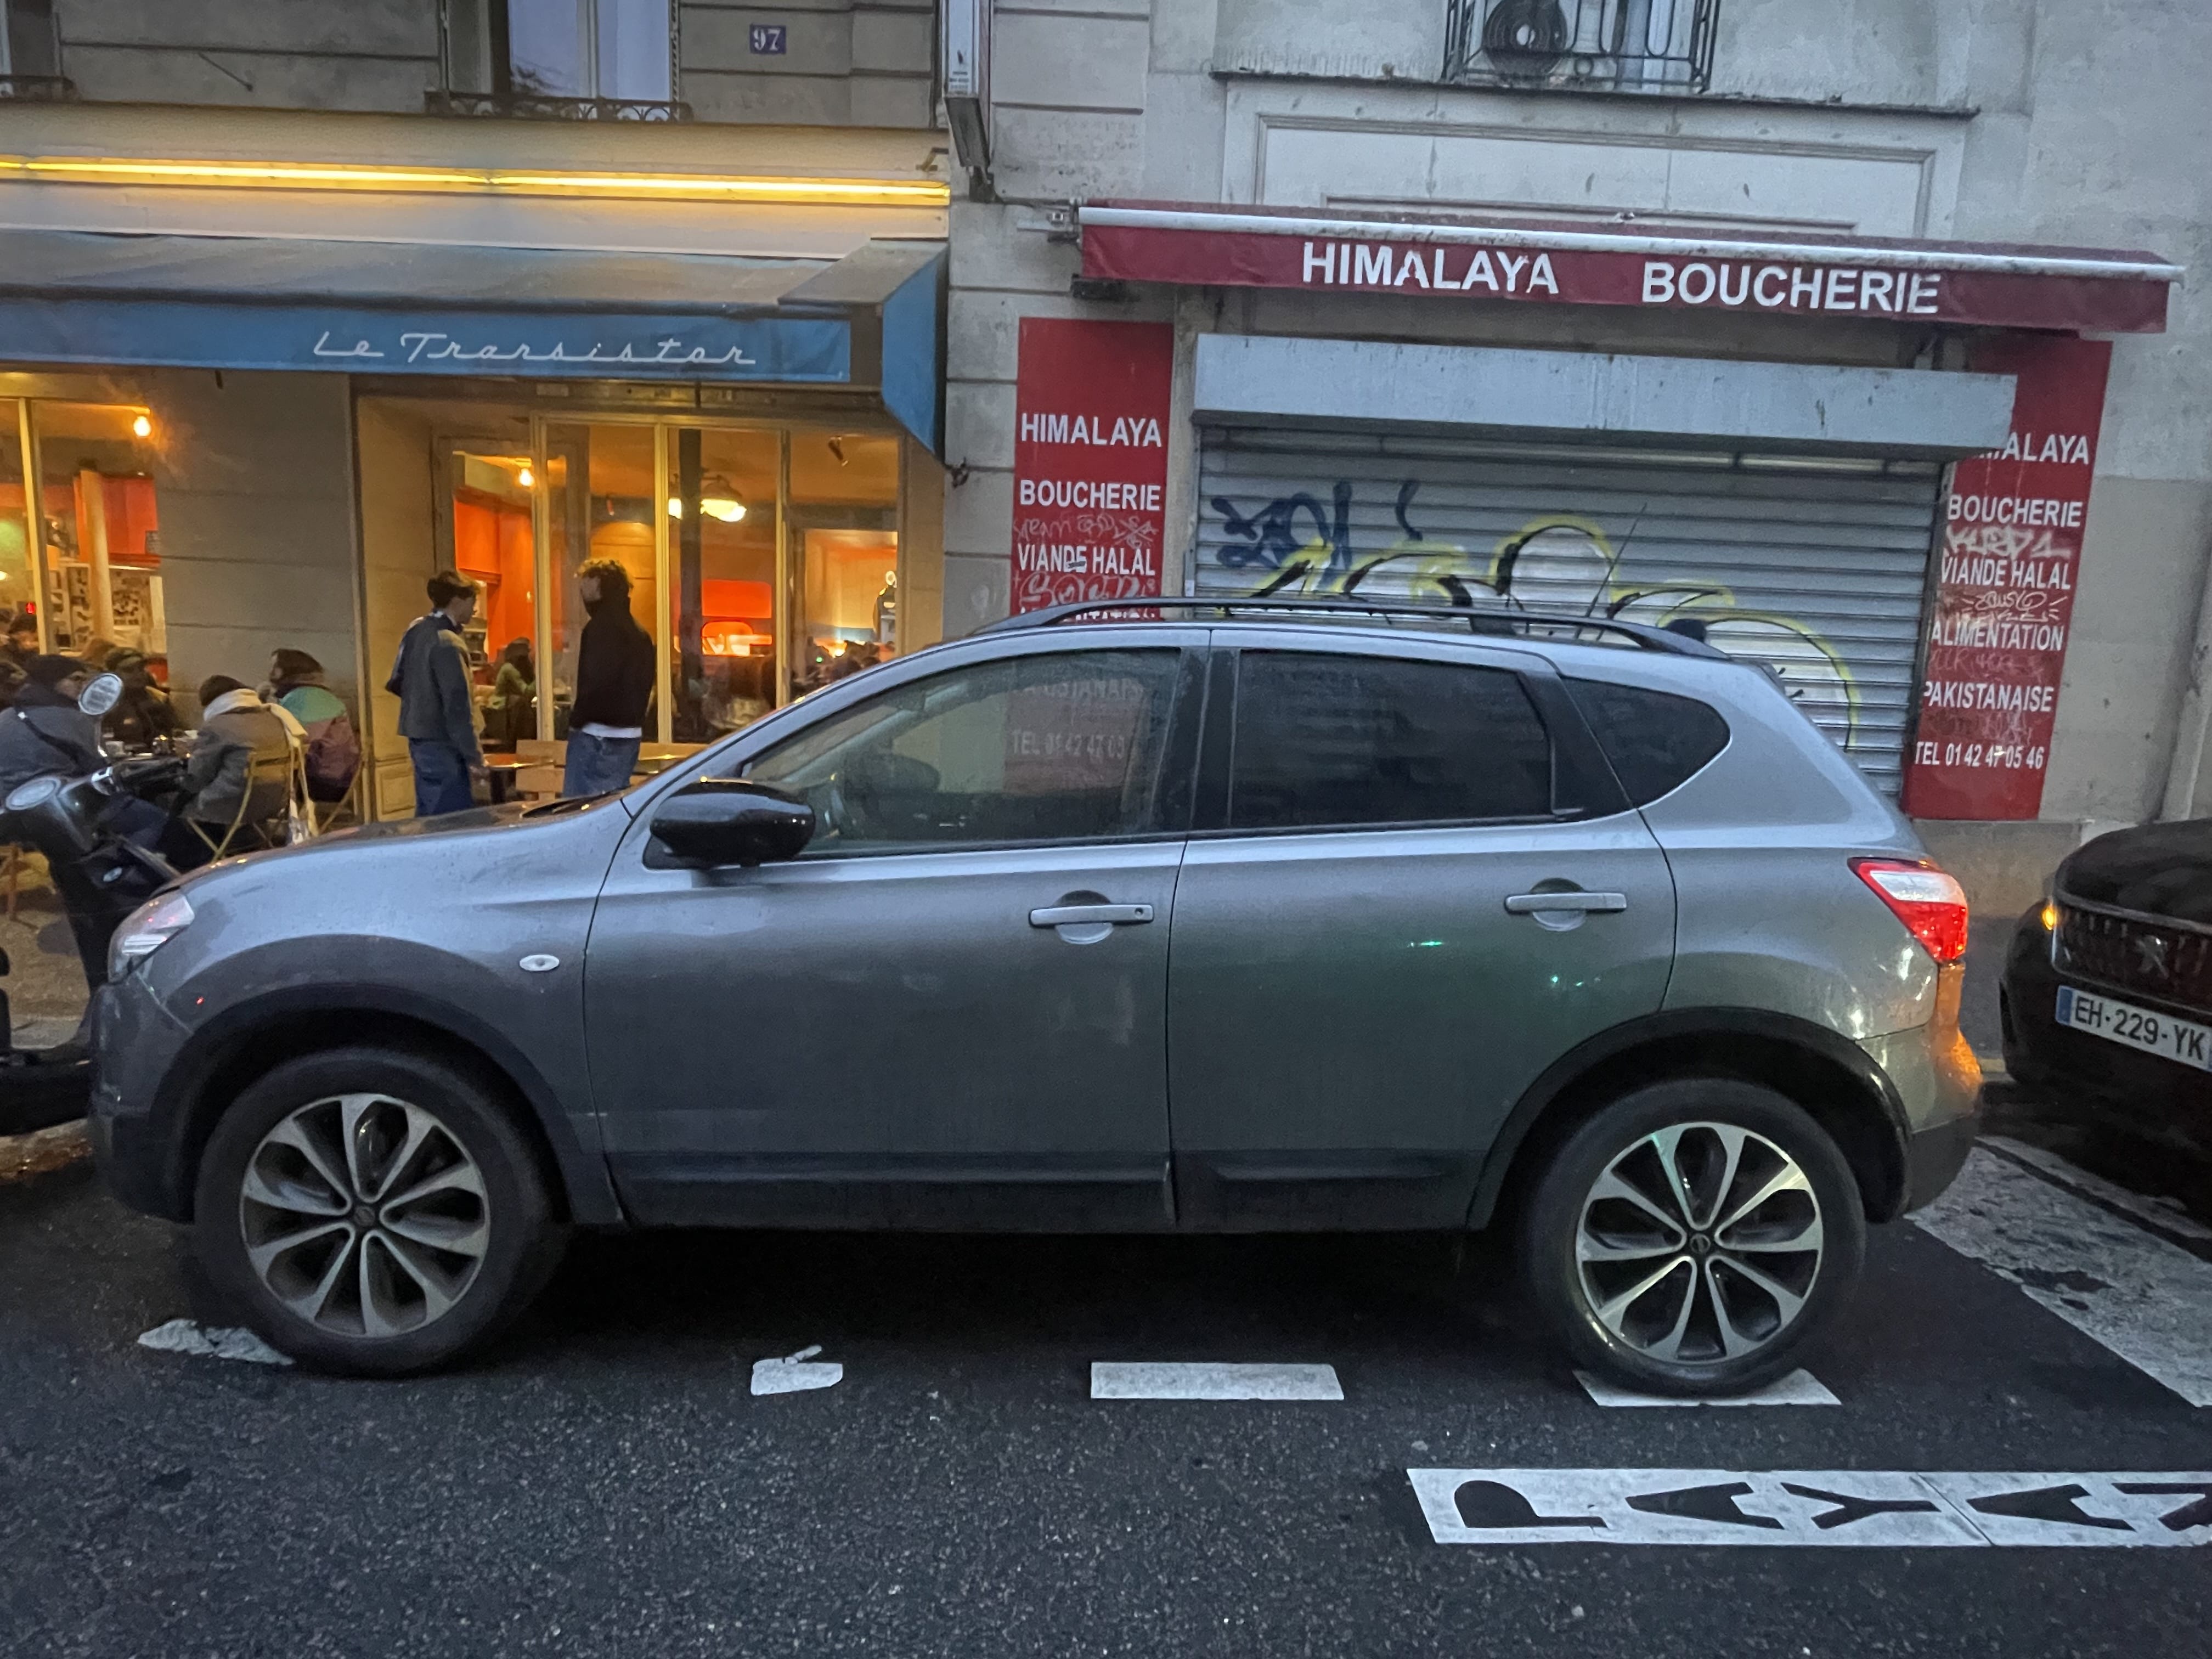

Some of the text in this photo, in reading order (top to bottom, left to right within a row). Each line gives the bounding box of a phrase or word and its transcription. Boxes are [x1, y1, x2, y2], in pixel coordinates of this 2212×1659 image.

[753, 27, 782, 52] 97
[1302, 241, 1941, 315] HIMALAYA BOUCHERIE
[313, 332, 756, 365] Le Transistor
[1021, 413, 1163, 448] HIMALAYA
[1979, 432, 2089, 465] ALAYA
[1019, 479, 1161, 511] BOUCHERIE
[1948, 494, 2084, 527] BOUCHERIE
[1018, 543, 1155, 576] VIANDE HALAL
[1941, 555, 2071, 590] VIANDE HALAL
[1931, 620, 2064, 651] ALIMENTATION
[1915, 741, 1940, 766] TEL
[1946, 743, 1960, 766] 01
[1964, 744, 1982, 767] 42
[2005, 745, 2024, 769] 05
[2027, 746, 2045, 769] 46
[2074, 996, 2206, 1061] EH-229-YK
